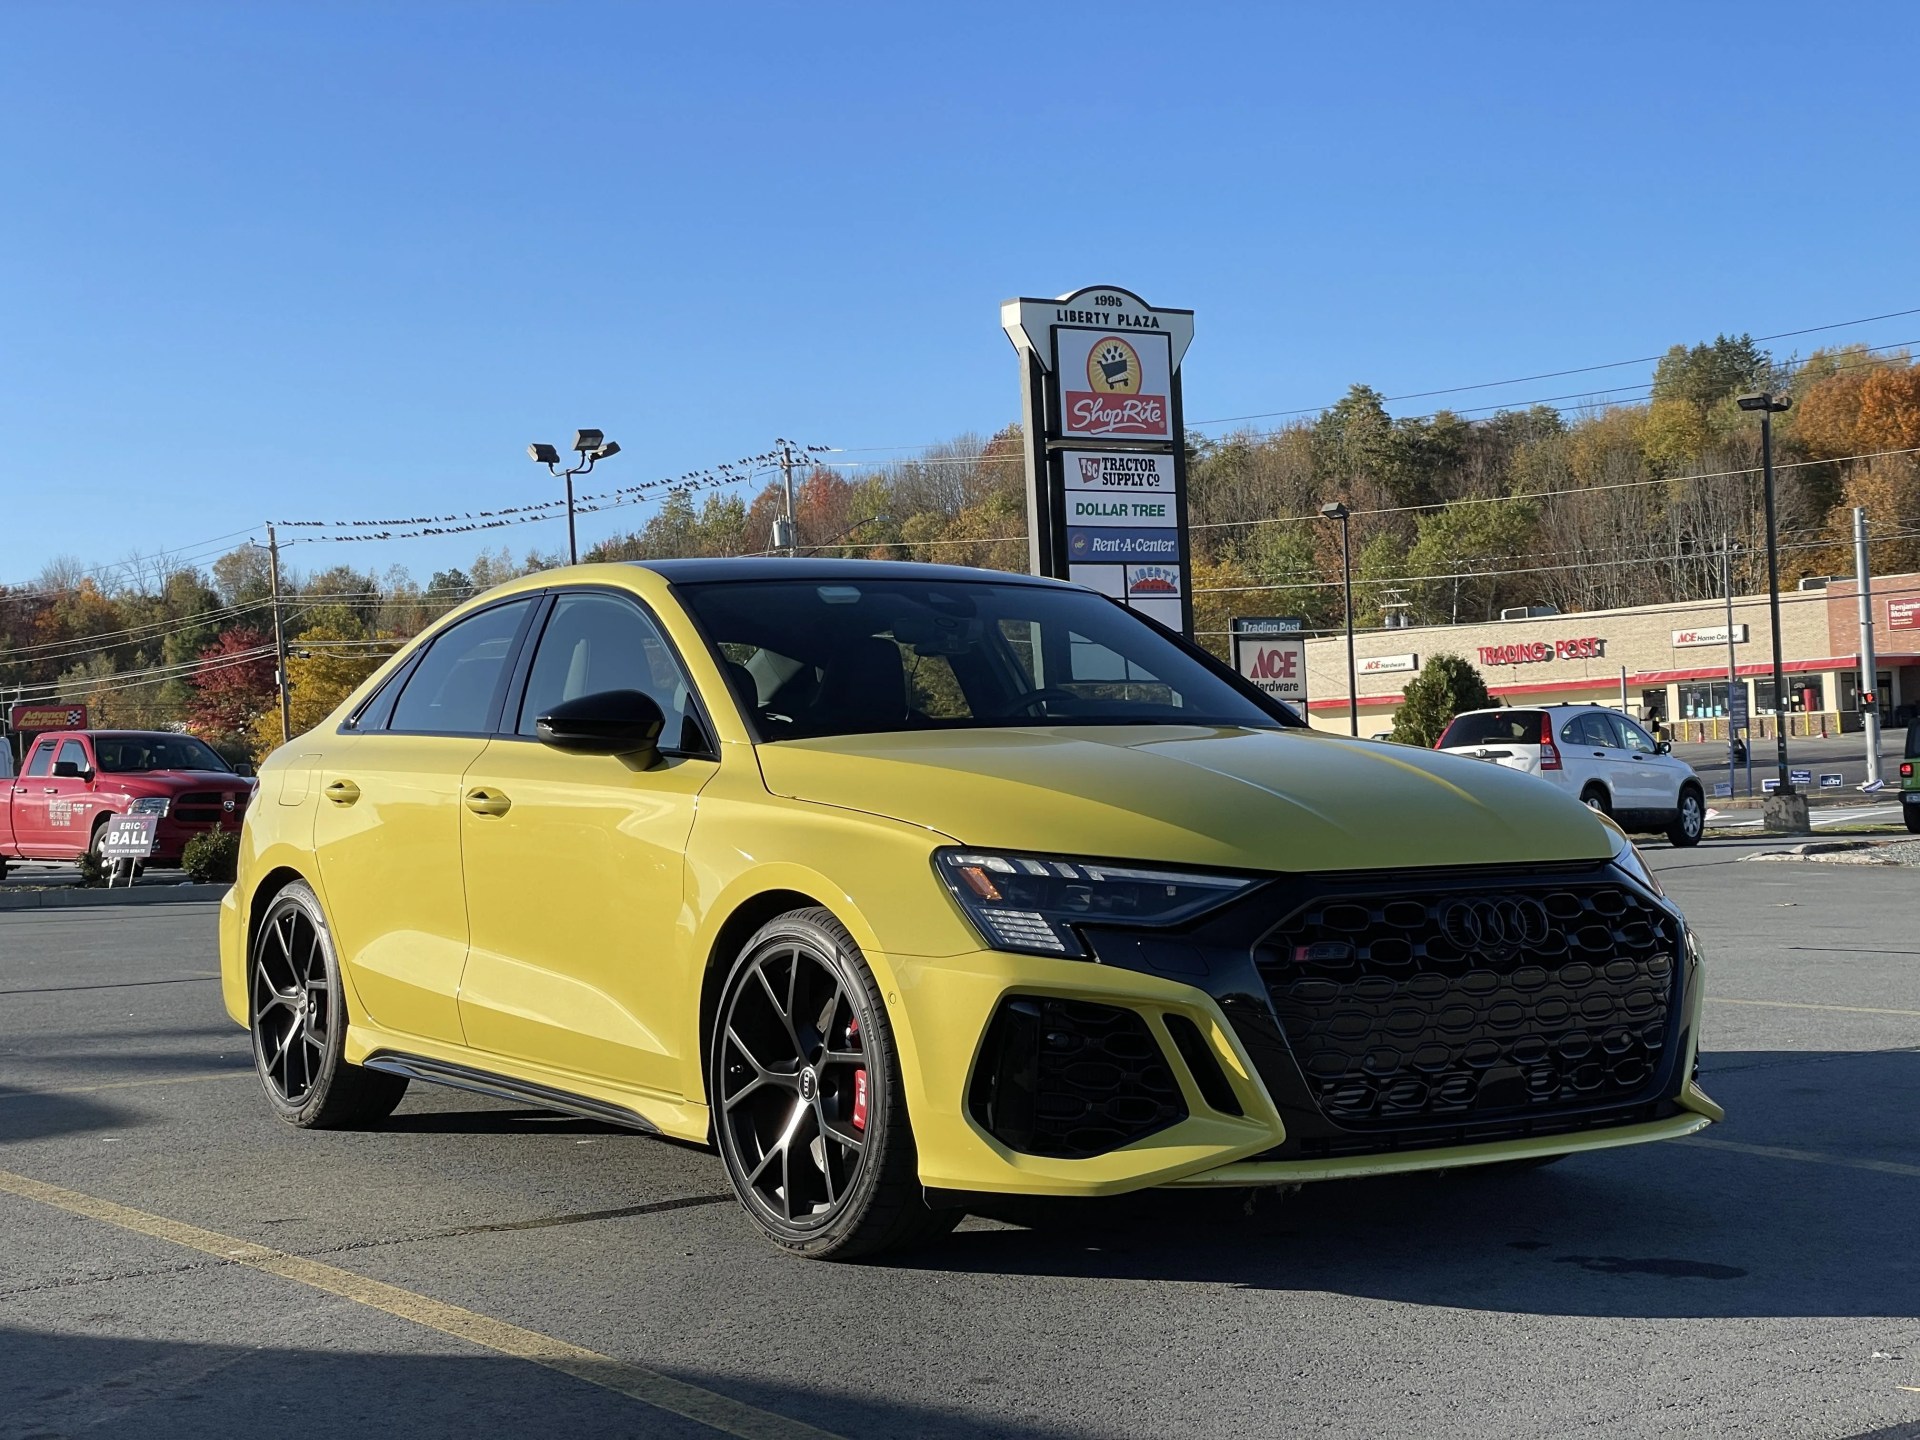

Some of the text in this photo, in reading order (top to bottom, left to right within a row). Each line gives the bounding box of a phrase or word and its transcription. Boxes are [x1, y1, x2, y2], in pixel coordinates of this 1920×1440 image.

[1094, 295, 1123, 307] 1995
[1057, 309, 1160, 329] LIBERTY PLAZA
[1072, 397, 1161, 432] ShopRite
[1080, 458, 1099, 479] TSC
[1102, 457, 1156, 473] TRACTOR
[1102, 472, 1144, 487] SUPPLY
[1075, 502, 1166, 517] DOLLAR TREE
[1128, 566, 1179, 586] LIBERTY
[1279, 622, 1301, 634] Post
[1678, 632, 1697, 643] ACE
[1477, 637, 1599, 665] TRADING POST
[1250, 646, 1298, 679] ACE
[1364, 660, 1381, 670] ACE
[24, 710, 66, 719] Advance
[18, 719, 40, 727] Auto
[120, 822, 141, 830] ERIC
[108, 831, 149, 845] BALL
[858, 1077, 866, 1107] RS
